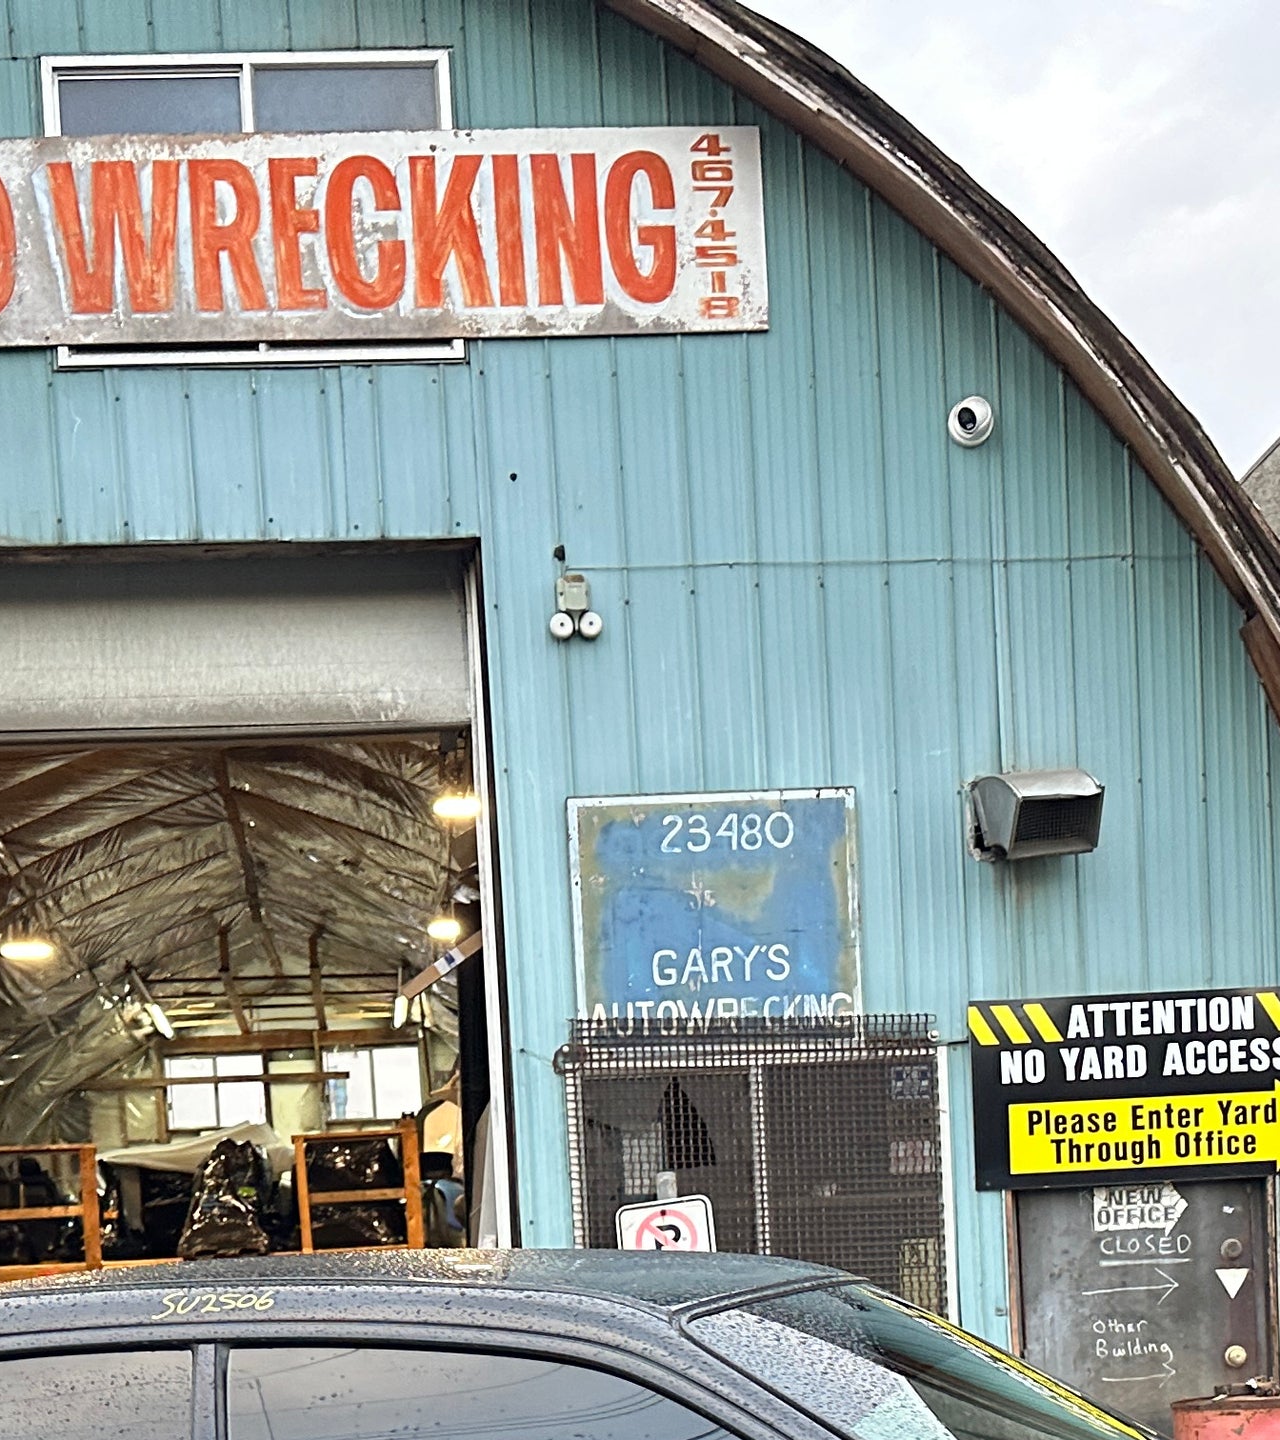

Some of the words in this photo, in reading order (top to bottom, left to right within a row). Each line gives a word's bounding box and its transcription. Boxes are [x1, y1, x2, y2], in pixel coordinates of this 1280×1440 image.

[45, 150, 678, 315] WRECKING
[660, 811, 795, 854] 23480
[652, 943, 791, 987] GARY'S
[1066, 996, 1255, 1040] ATTENTION
[1000, 1049, 1045, 1085] NO
[1063, 1045, 1147, 1081] YARD
[1028, 1109, 1117, 1136] Please
[1131, 1103, 1205, 1131] Enter
[1217, 1098, 1278, 1126] Yard
[1050, 1135, 1161, 1165] Through
[1175, 1130, 1257, 1157] Office
[1108, 1188, 1160, 1206] NEW
[1097, 1206, 1176, 1225] OFFICE
[1100, 1234, 1192, 1255] CLOSED
[151, 1290, 275, 1320] SU2506
[1092, 1318, 1148, 1335] Other
[1095, 1339, 1173, 1363] Building
